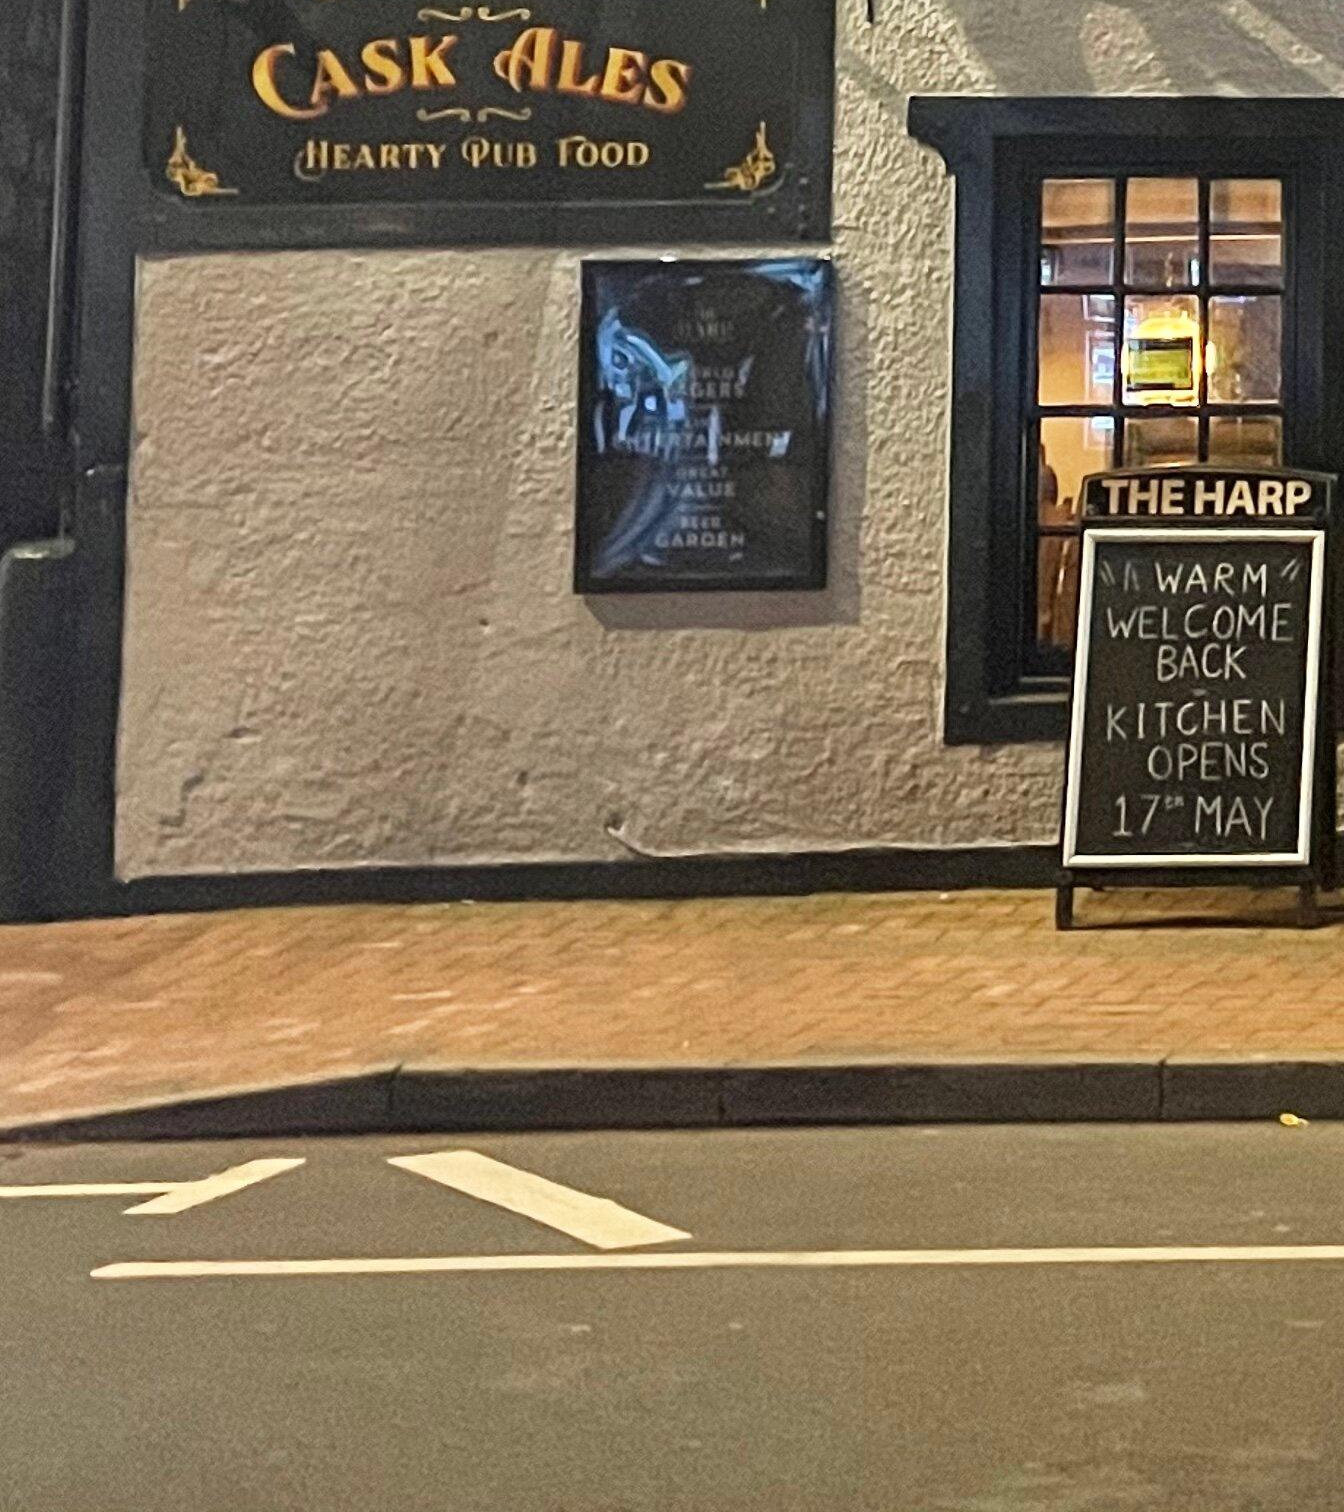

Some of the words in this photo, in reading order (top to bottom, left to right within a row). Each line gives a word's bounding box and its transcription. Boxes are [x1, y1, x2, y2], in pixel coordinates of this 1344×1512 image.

[251, 34, 460, 120] CASK
[493, 26, 694, 115] ALES
[293, 138, 446, 182] HEARTY
[461, 136, 537, 169] PUB
[558, 135, 650, 169] FOOD
[1101, 479, 1185, 515] THE
[1194, 480, 1312, 516] HARP
[654, 531, 746, 549] GARDEN
[1107, 602, 1293, 642] WELCOME
[1156, 642, 1247, 683] BACK
[1107, 698, 1285, 741] KITCHEN
[1147, 742, 1270, 781] OPENS
[1194, 795, 1274, 840] MAY
